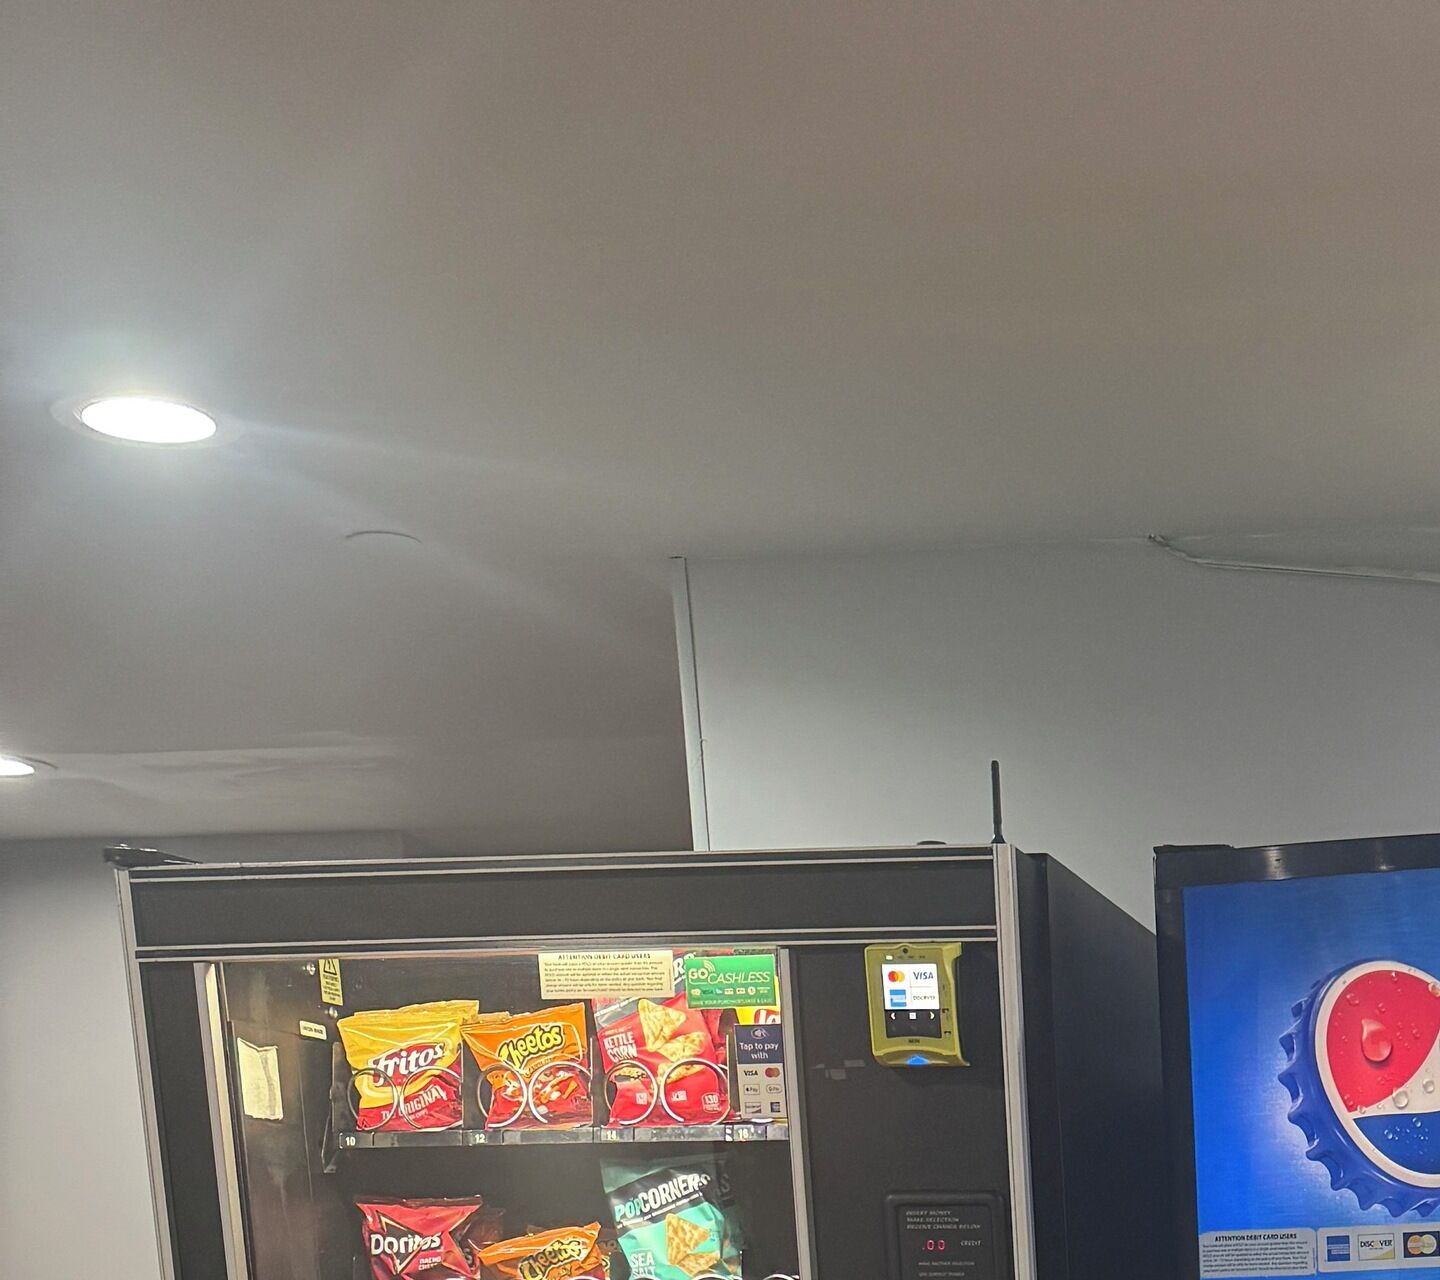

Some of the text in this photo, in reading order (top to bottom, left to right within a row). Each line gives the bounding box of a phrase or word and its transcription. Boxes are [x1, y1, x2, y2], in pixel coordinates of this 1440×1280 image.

[688, 966, 770, 984] GO CASHLESS
[913, 971, 934, 980] VISA
[603, 1031, 635, 1049] KETTLE
[739, 1042, 754, 1051] Tap
[765, 1043, 779, 1051] pay
[498, 1026, 565, 1072] Cheetos
[606, 1042, 638, 1063] CORN
[751, 1052, 768, 1060] with
[368, 1041, 445, 1086] Fritos
[475, 1134, 485, 1144] 12
[738, 1129, 749, 1139] 16
[345, 1137, 357, 1146] 10
[370, 1232, 442, 1255] Doritos
[1215, 1234, 1246, 1242] ATTENTION
[1280, 1233, 1297, 1241] USERS
[630, 1251, 655, 1267] SEA
